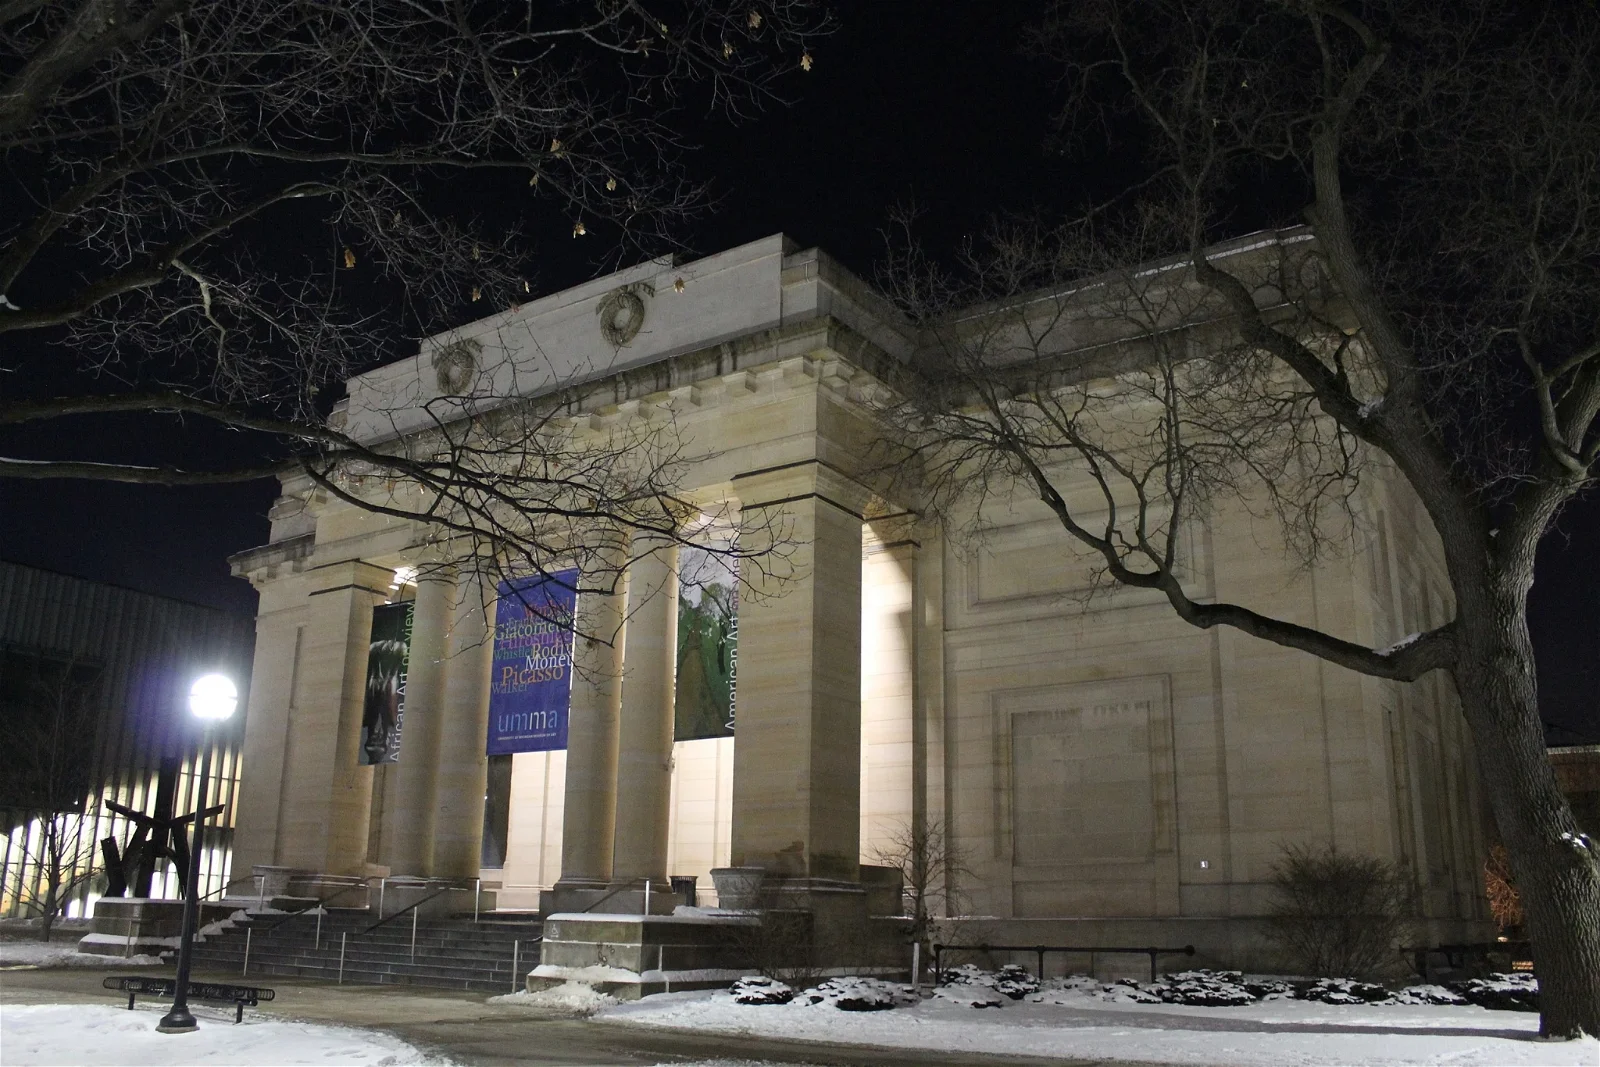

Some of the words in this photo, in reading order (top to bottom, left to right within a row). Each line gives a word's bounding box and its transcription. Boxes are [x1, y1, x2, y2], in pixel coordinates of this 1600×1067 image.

[525, 655, 572, 672] Monet
[397, 671, 408, 696] Art
[501, 665, 564, 687] Picasso
[491, 680, 528, 695] Walker
[390, 702, 405, 762] African
[498, 710, 558, 733] umma
